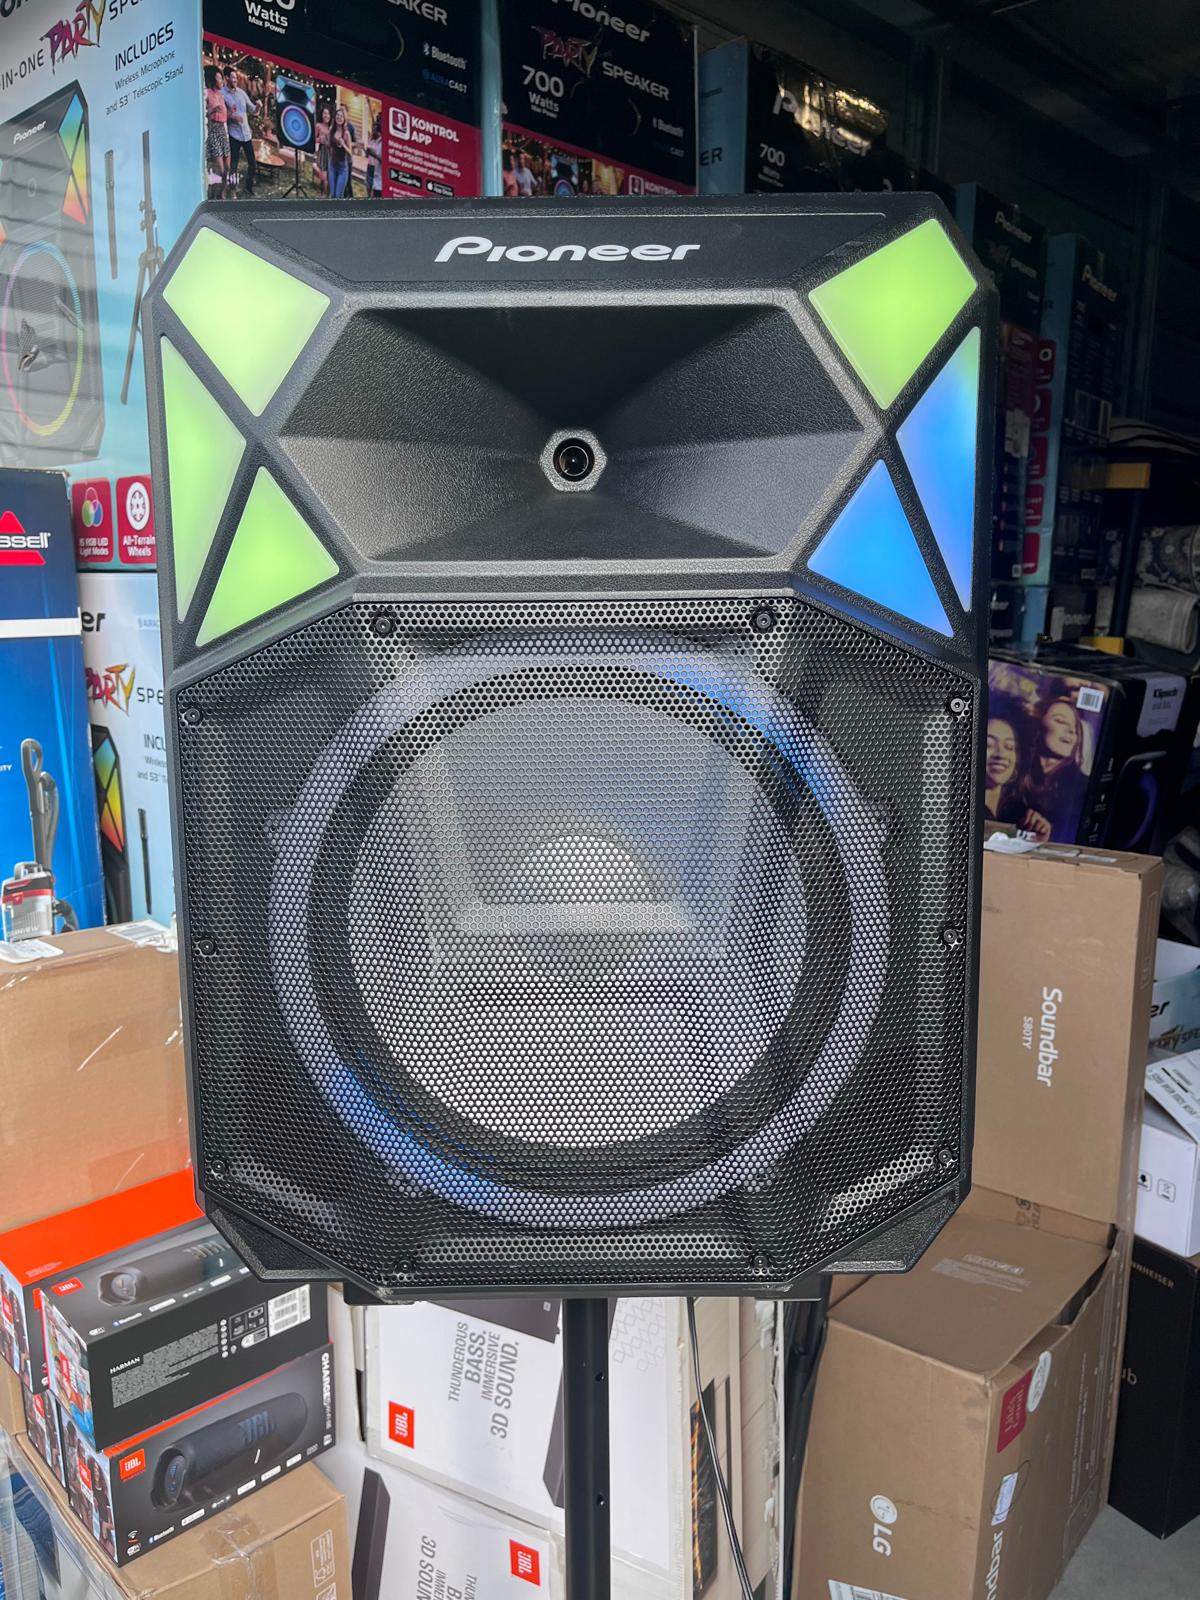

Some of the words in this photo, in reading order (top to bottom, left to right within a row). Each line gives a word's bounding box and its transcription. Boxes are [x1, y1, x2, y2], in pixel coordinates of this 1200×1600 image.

[244, 0, 289, 27] Watts
[384, 0, 448, 26] AKER
[115, 21, 174, 72] INCLUDES
[114, 70, 139, 91] Wireless
[140, 51, 176, 77] Microphone
[521, 64, 565, 98] 700
[602, 60, 670, 101] SPEAKER
[106, 102, 118, 116] and
[132, 76, 164, 101] Telescopic
[165, 65, 184, 83] Stand
[13, 120, 47, 144] Pioneer
[411, 131, 433, 146] APP
[412, 116, 460, 143] KONTROL
[700, 148, 723, 166] ER
[759, 142, 786, 167] 700
[434, 236, 701, 263] Pioneer
[127, 546, 152, 557] Wheels
[81, 611, 106, 632] er
[1037, 986, 1063, 1087] Soundbar
[109, 1356, 140, 1374] HARMAN
[448, 1321, 469, 1402] THUNDEROUS
[464, 1330, 487, 1384] BASS.
[480, 1331, 501, 1401] IMMERSIVE
[494, 1341, 519, 1410] SOUND.
[395, 1412, 409, 1438] JBL
[490, 1412, 509, 1439] 3D
[125, 1457, 142, 1471] JBL
[421, 1535, 437, 1559] 3D
[872, 1523, 892, 1557] LG
[518, 1551, 533, 1574] JBL
